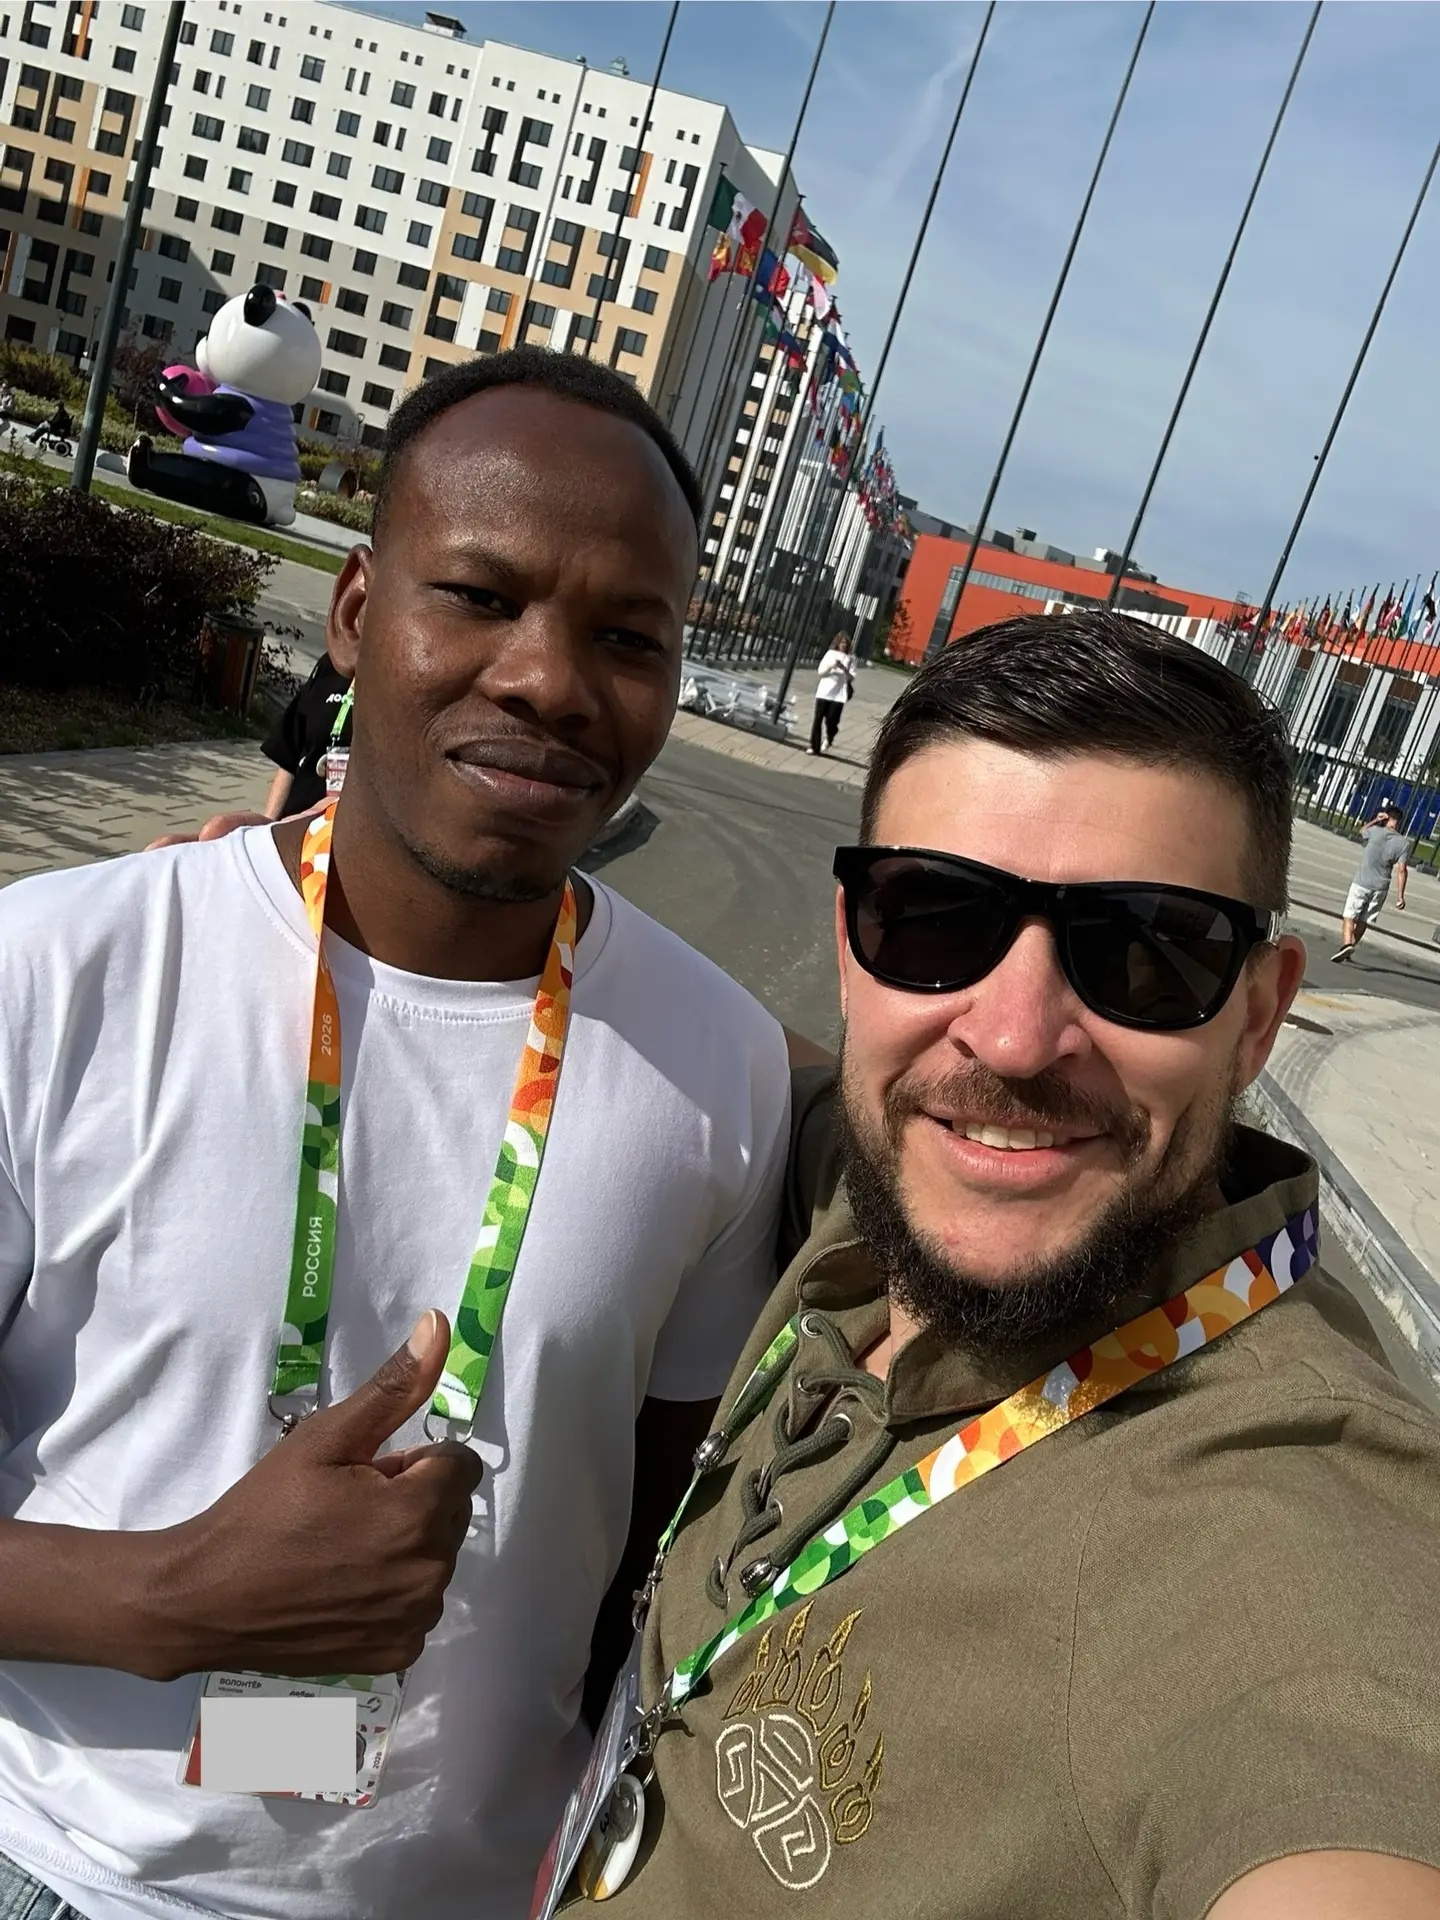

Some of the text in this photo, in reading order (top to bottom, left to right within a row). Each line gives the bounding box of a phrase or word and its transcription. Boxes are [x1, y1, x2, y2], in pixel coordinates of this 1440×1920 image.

[321, 1012, 332, 1057] 2026
[302, 1216, 322, 1298] РОССИЯ
[219, 1677, 262, 1689] ВОЛОНТЁР
